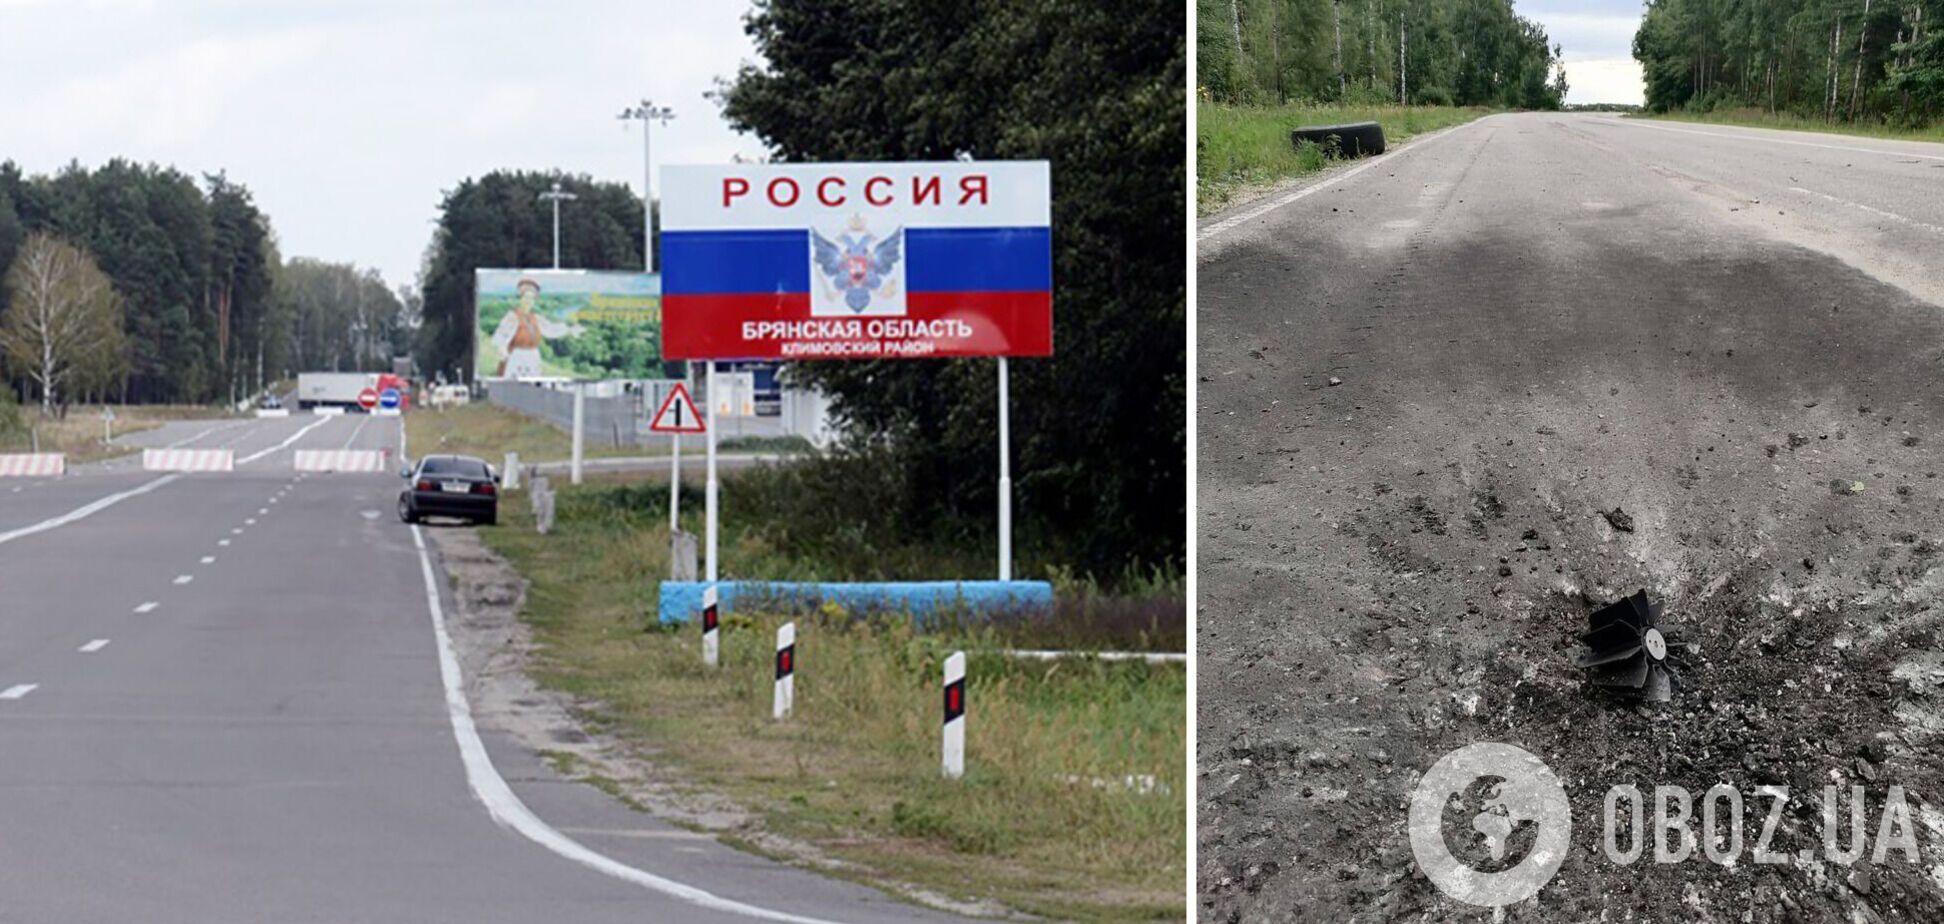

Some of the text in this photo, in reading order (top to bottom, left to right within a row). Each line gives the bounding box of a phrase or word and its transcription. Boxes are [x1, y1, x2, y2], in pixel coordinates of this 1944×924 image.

[722, 175, 989, 208] РОССИЯ
[742, 319, 974, 340] БРЯНСКАЯ ОБЛАСТЬ
[780, 340, 936, 355] КЛИМОВСКИЙ РАЙОН
